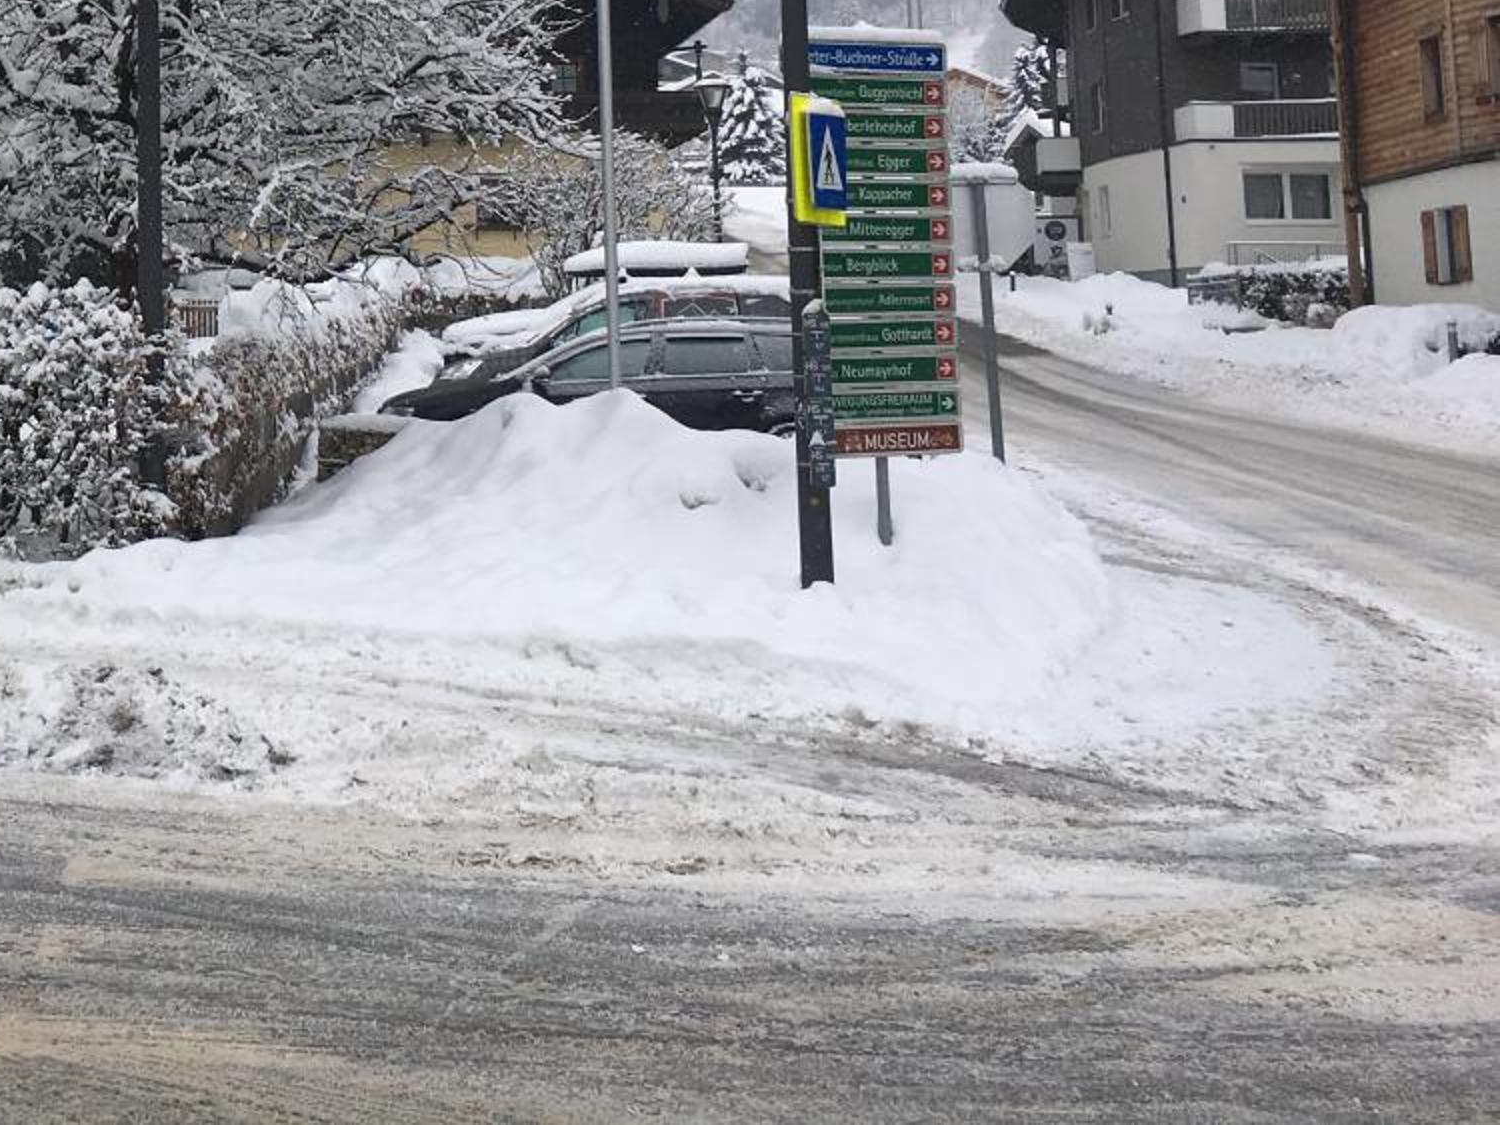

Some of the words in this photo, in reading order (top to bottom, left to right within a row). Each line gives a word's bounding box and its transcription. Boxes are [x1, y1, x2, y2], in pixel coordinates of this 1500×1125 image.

[808, 49, 924, 66] eter-Buchner-Straße
[847, 119, 917, 135] berlehenhof
[877, 154, 911, 171] Egger
[859, 186, 913, 203] Kappacher
[845, 258, 899, 275] Bergblick
[841, 363, 912, 379] Neumayrhof
[864, 430, 930, 451] MUSEUM
